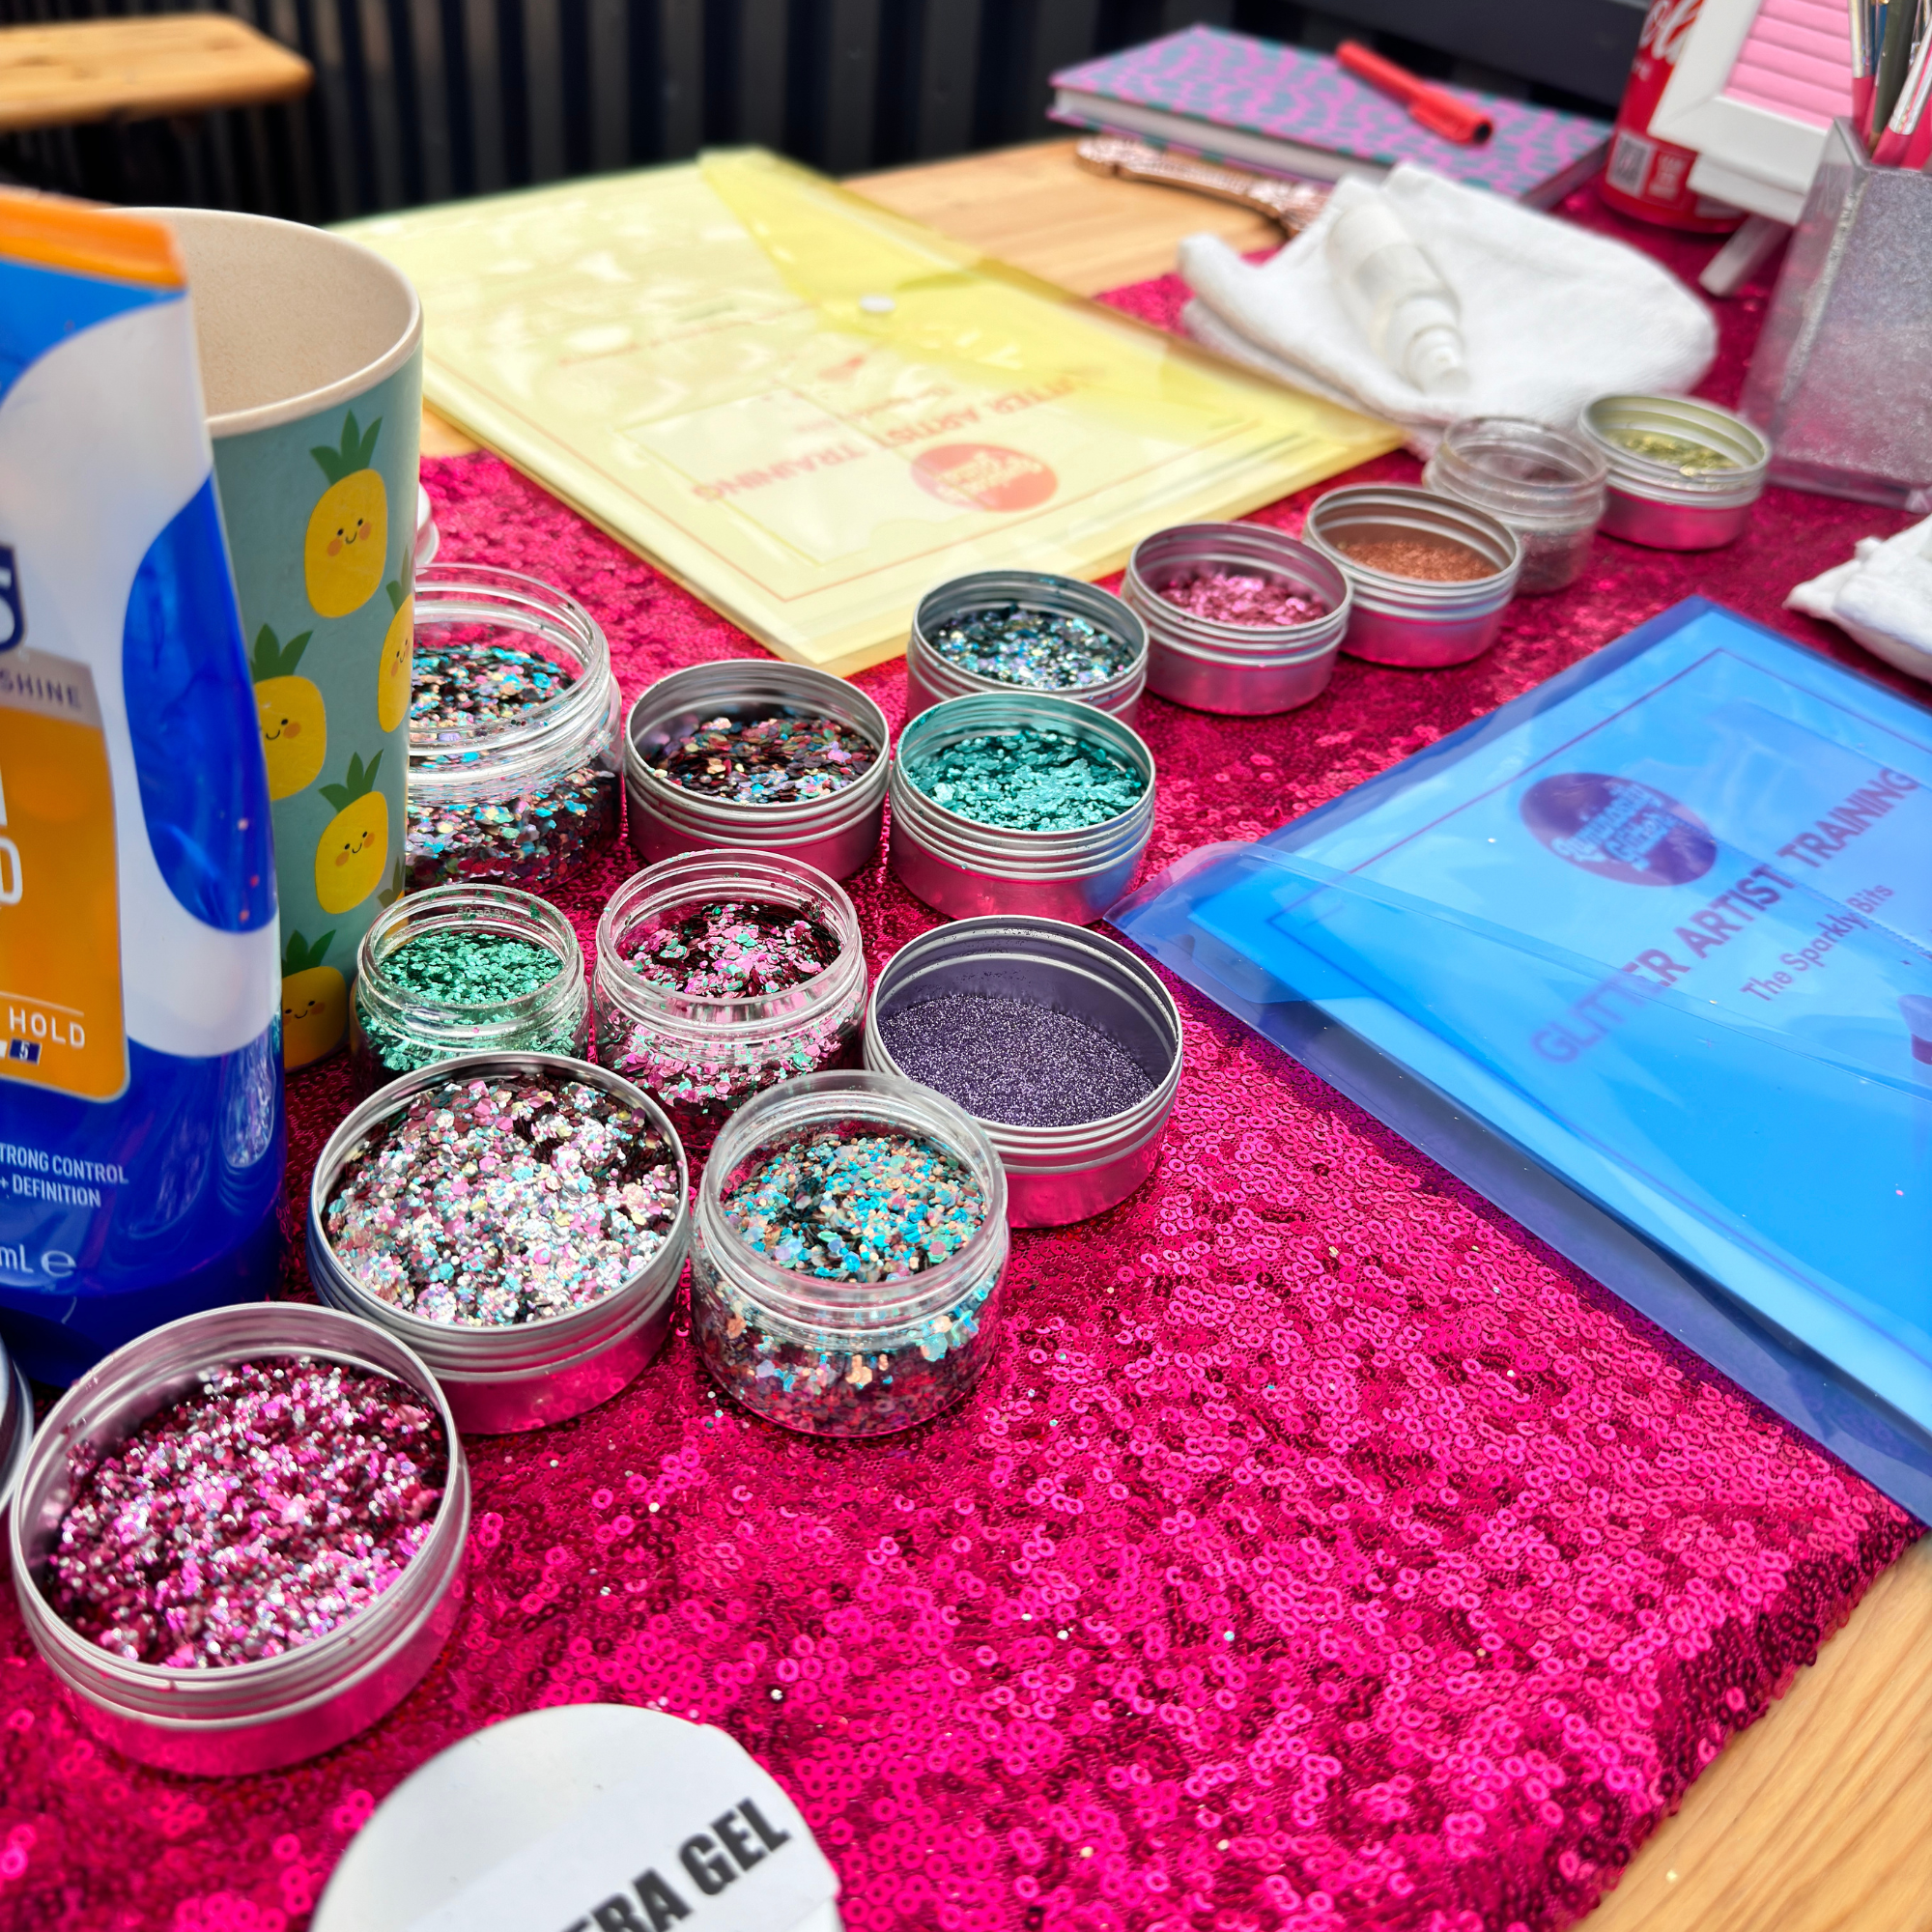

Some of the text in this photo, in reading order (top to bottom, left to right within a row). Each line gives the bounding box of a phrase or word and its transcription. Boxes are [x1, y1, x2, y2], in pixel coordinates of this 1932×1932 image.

[691, 443, 867, 502] TRAINING
[1531, 766, 1920, 1065] GLITTER ARTIST TRAINING
[1740, 884, 1895, 1002] The Sparkly Bits
[9, 1006, 86, 1049] HOLD
[13, 1173, 102, 1208] DEFINITION
[52, 1153, 129, 1184] CONTROL
[676, 1796, 793, 1896] GEL
